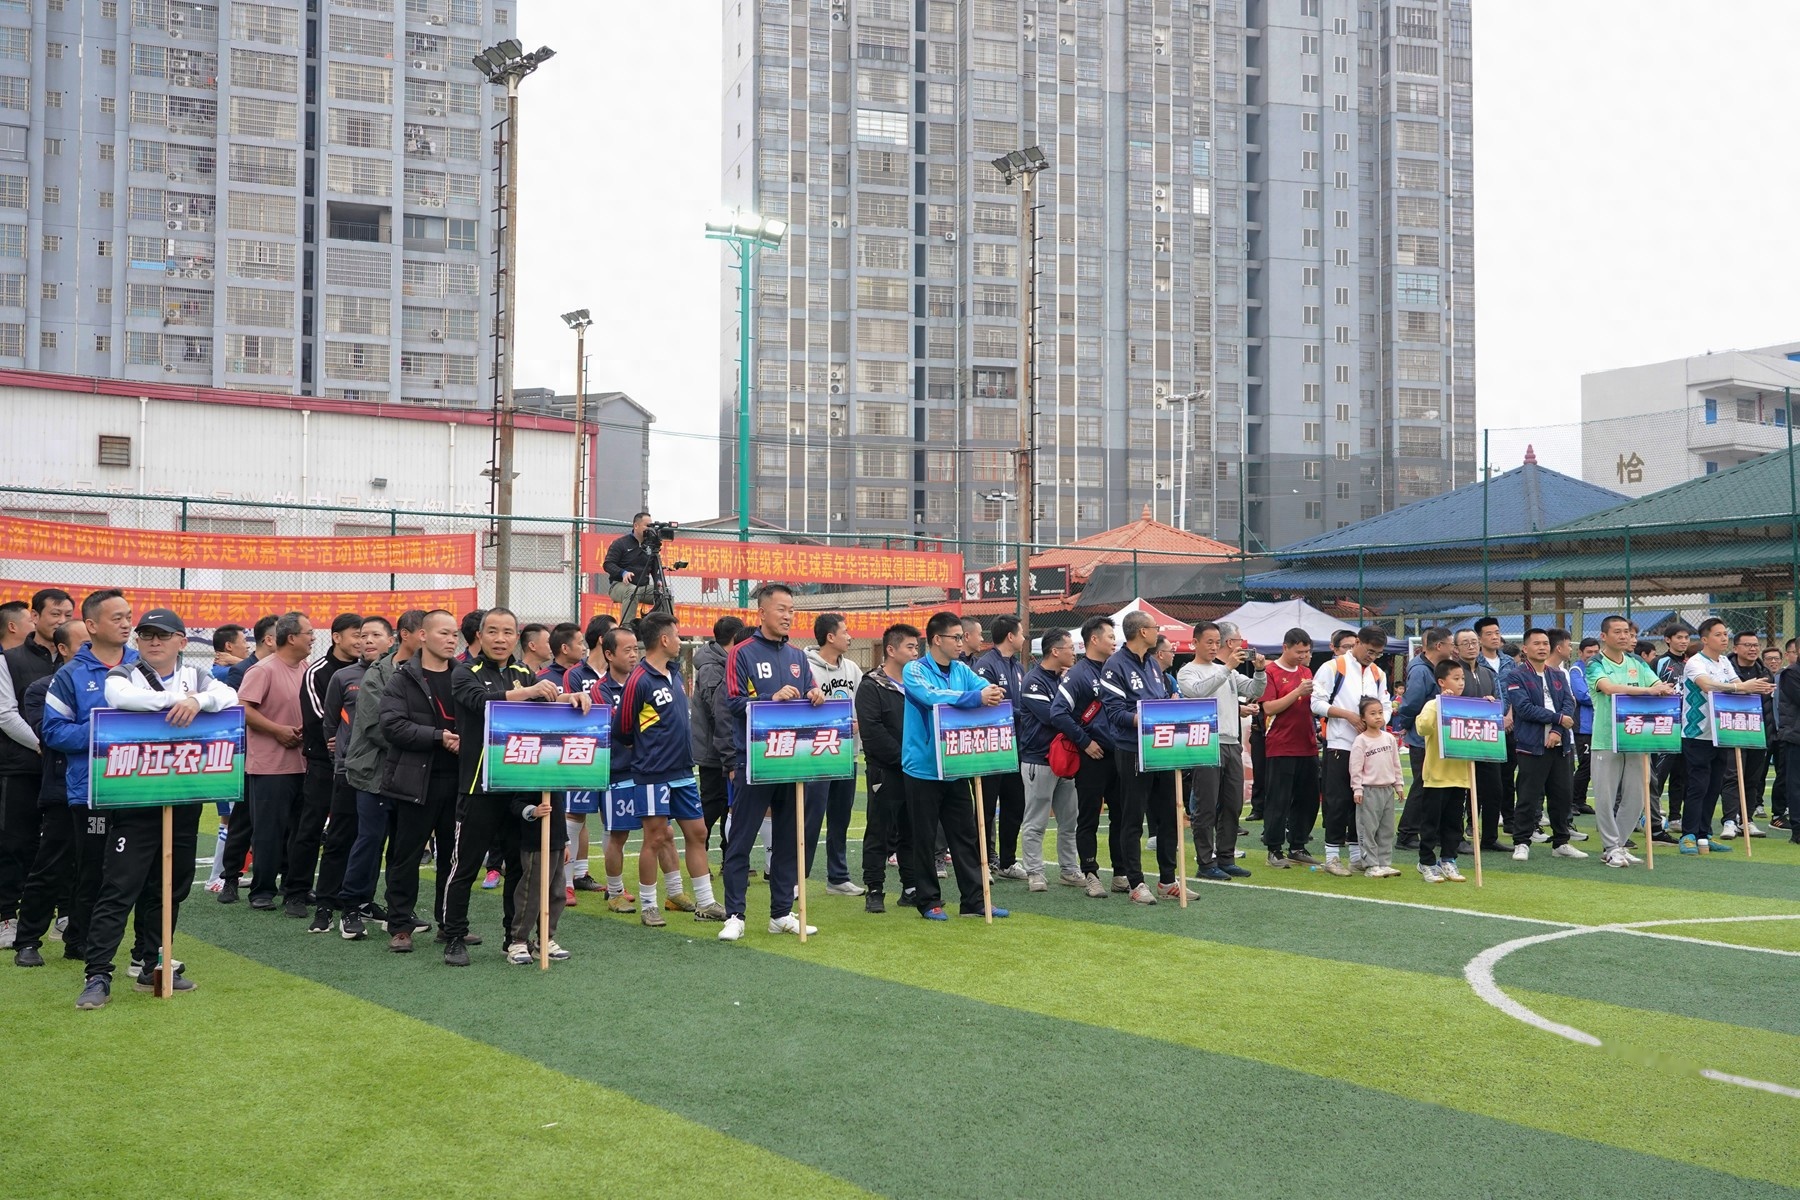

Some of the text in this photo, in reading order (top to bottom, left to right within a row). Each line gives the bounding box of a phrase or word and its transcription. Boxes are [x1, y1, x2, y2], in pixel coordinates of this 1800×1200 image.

[1617, 452, 1645, 484] 恰
[0, 520, 462, 568] 涤祝壮校附小班级家长足球嘉年华活动取得圆满成功!
[756, 661, 773, 679] 19
[1130, 677, 1144, 690] 25
[653, 687, 673, 707] 26
[1152, 723, 1210, 748] 百朋
[1450, 718, 1498, 742] 机关枪
[1624, 715, 1674, 735] 希望
[503, 734, 598, 765] 绿茵
[764, 729, 841, 758] 塘头
[945, 727, 1013, 756] 法院农信联
[104, 741, 235, 778] 柳江农业
[616, 799, 635, 816] 34
[87, 816, 106, 834] 36
[115, 836, 126, 853] 3
